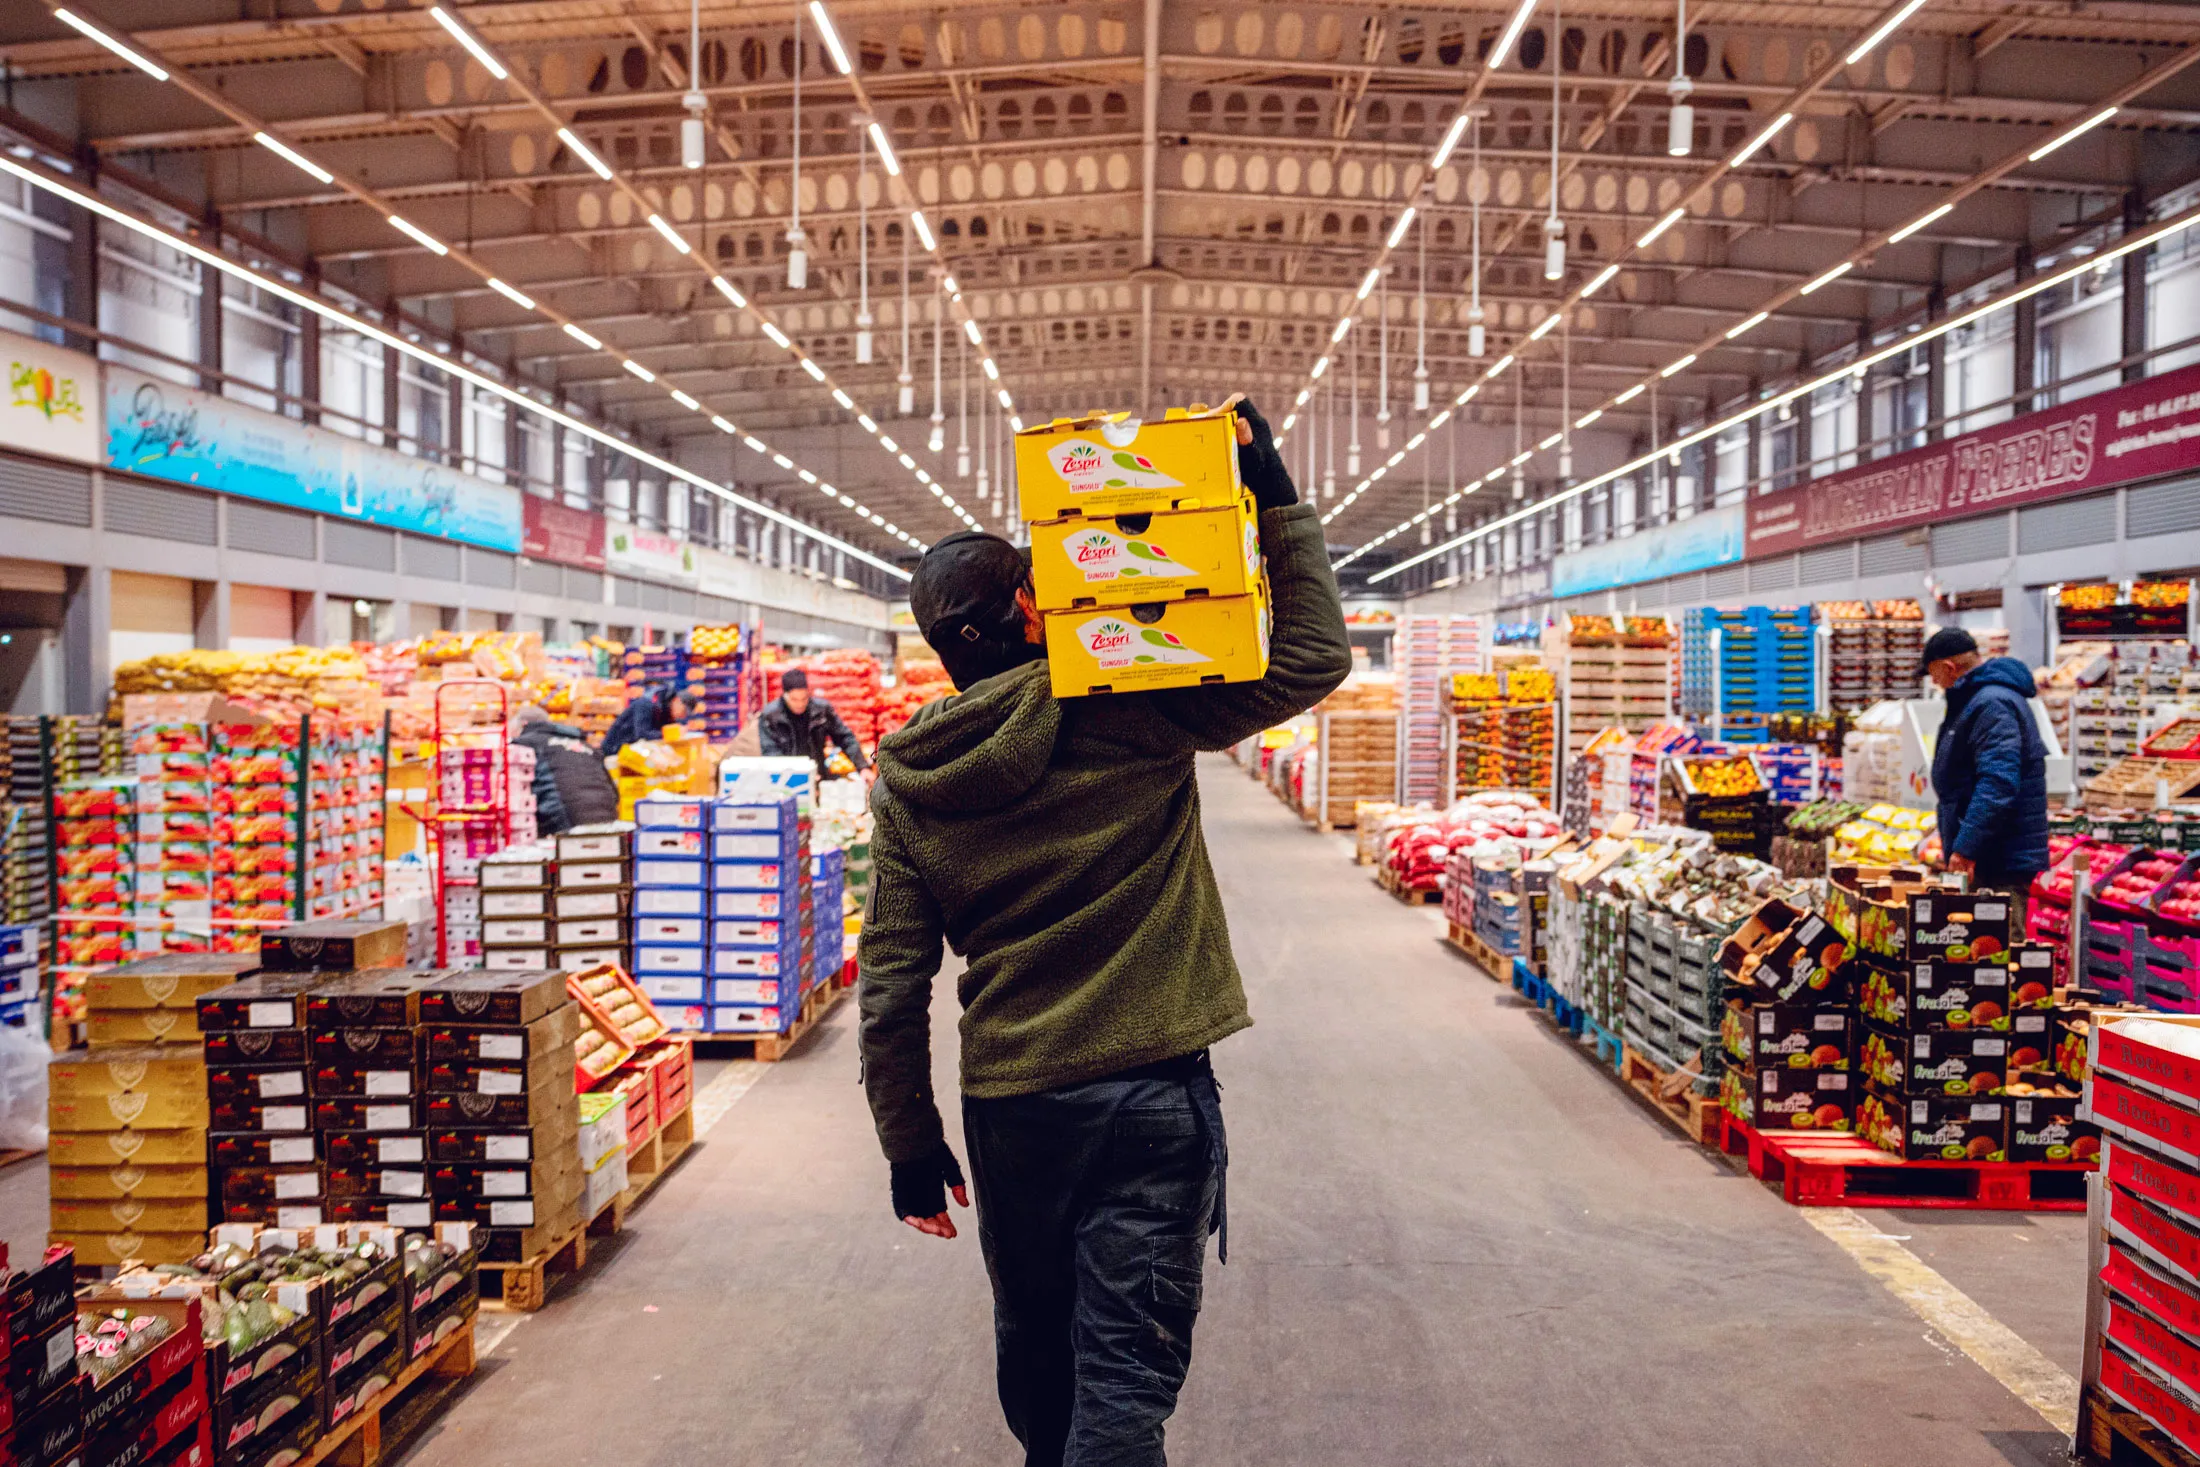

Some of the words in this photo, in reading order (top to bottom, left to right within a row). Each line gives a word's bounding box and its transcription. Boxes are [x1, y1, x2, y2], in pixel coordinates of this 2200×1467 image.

[1062, 456, 1101, 474] Zespri
[1077, 545, 1116, 563] Zespri
[1091, 633, 1130, 651] Zespri
[84, 1380, 133, 1428] AVOCATS
